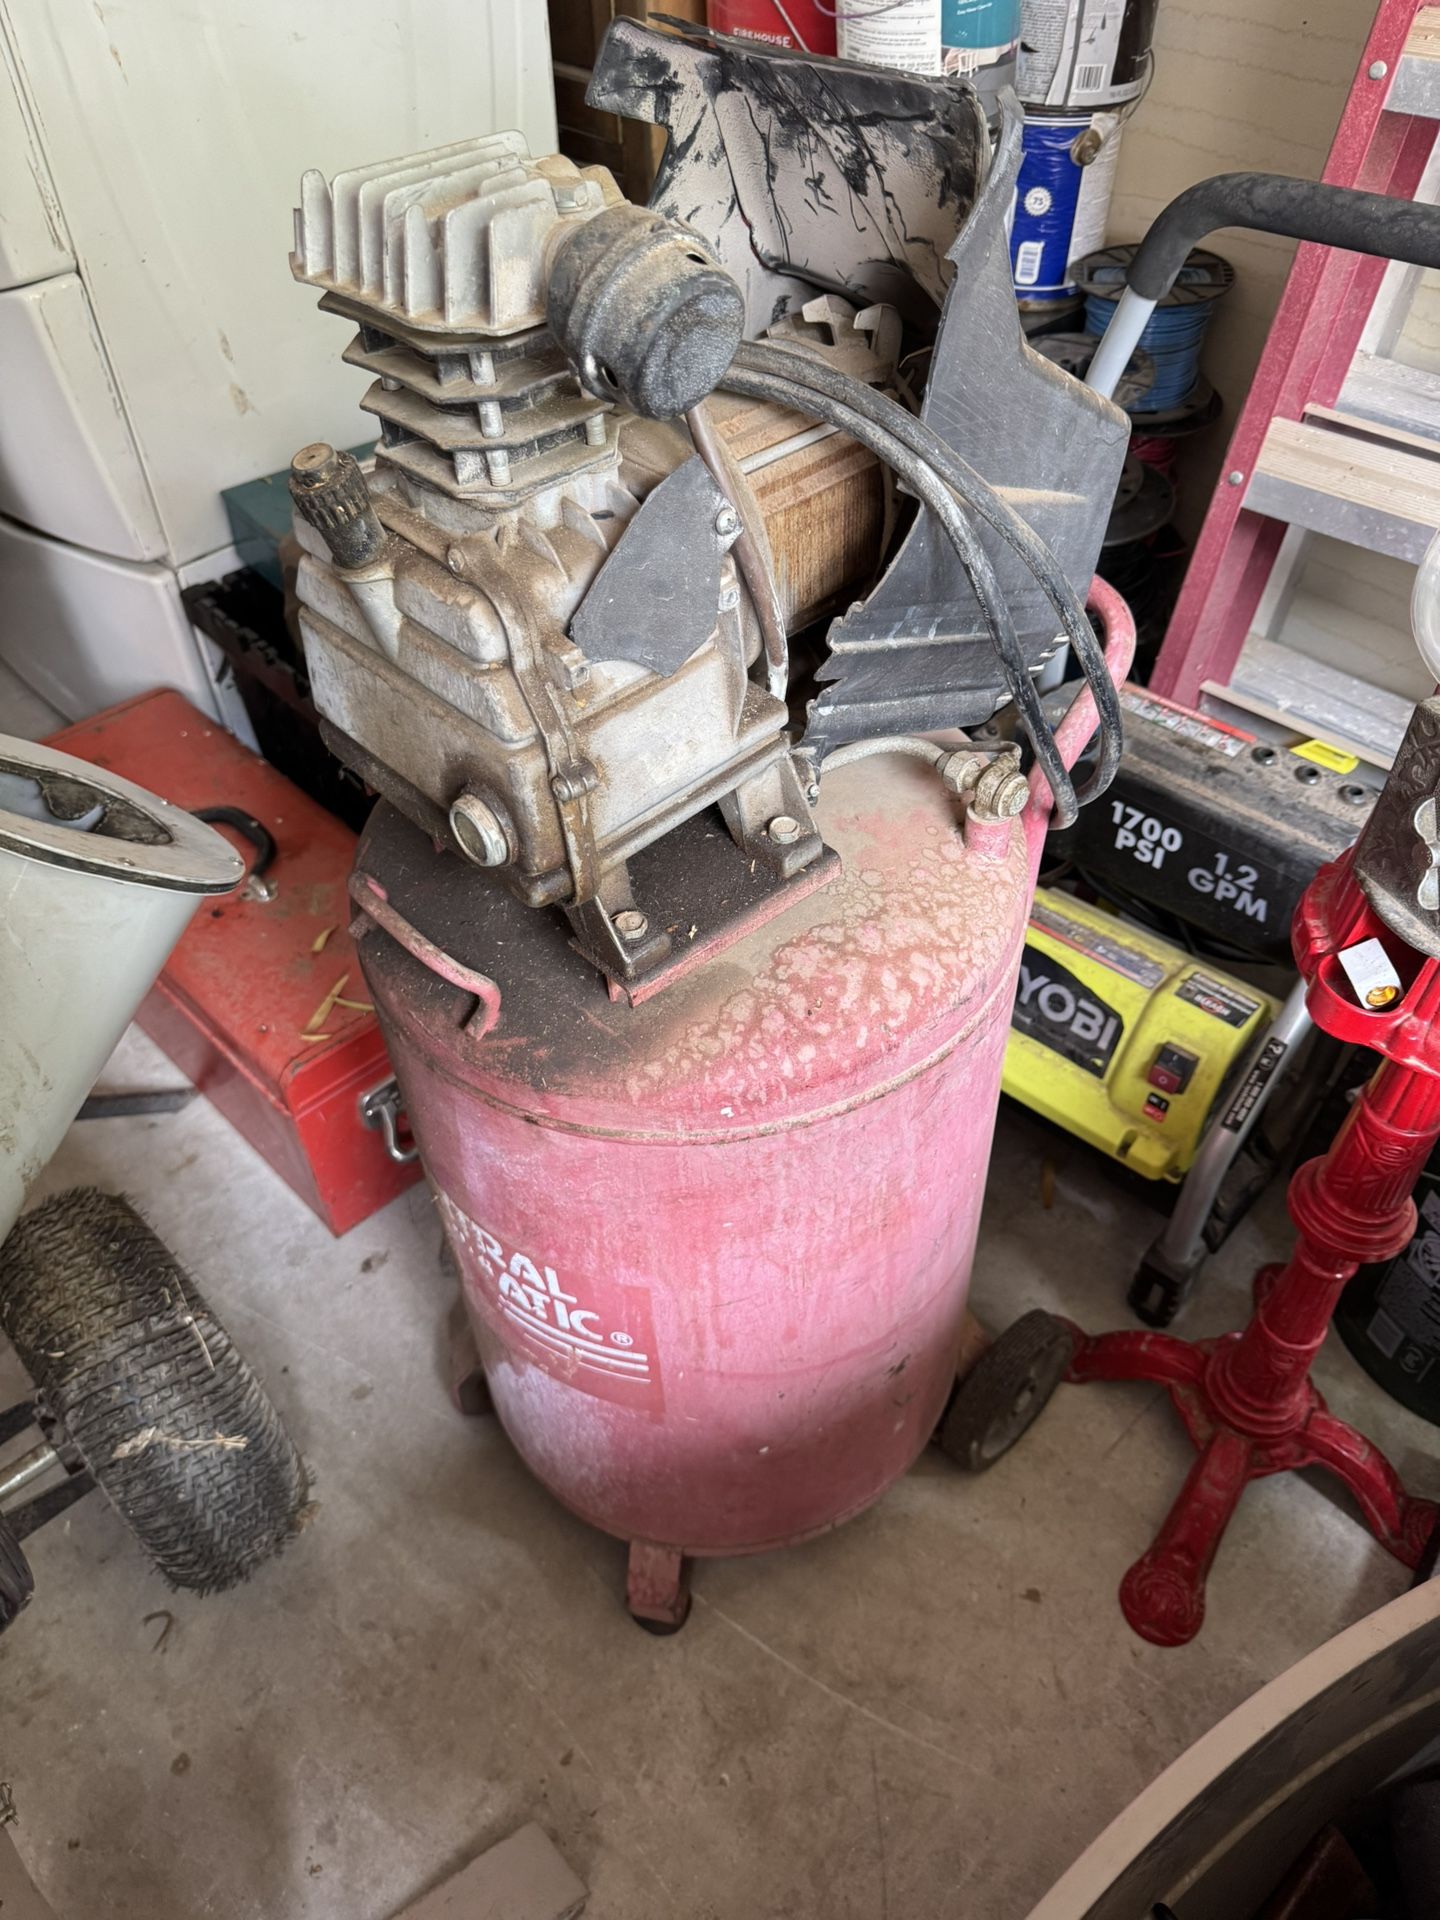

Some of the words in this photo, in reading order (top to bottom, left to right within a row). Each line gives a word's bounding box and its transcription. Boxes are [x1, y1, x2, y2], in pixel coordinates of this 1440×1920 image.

[732, 27, 793, 49] FIREHOUSE
[1111, 800, 1183, 852] 1700
[1114, 827, 1166, 870] PSI
[1187, 867, 1268, 923] GPM
[1214, 852, 1259, 892] 1.2
[1017, 964, 1118, 1050] YOBI
